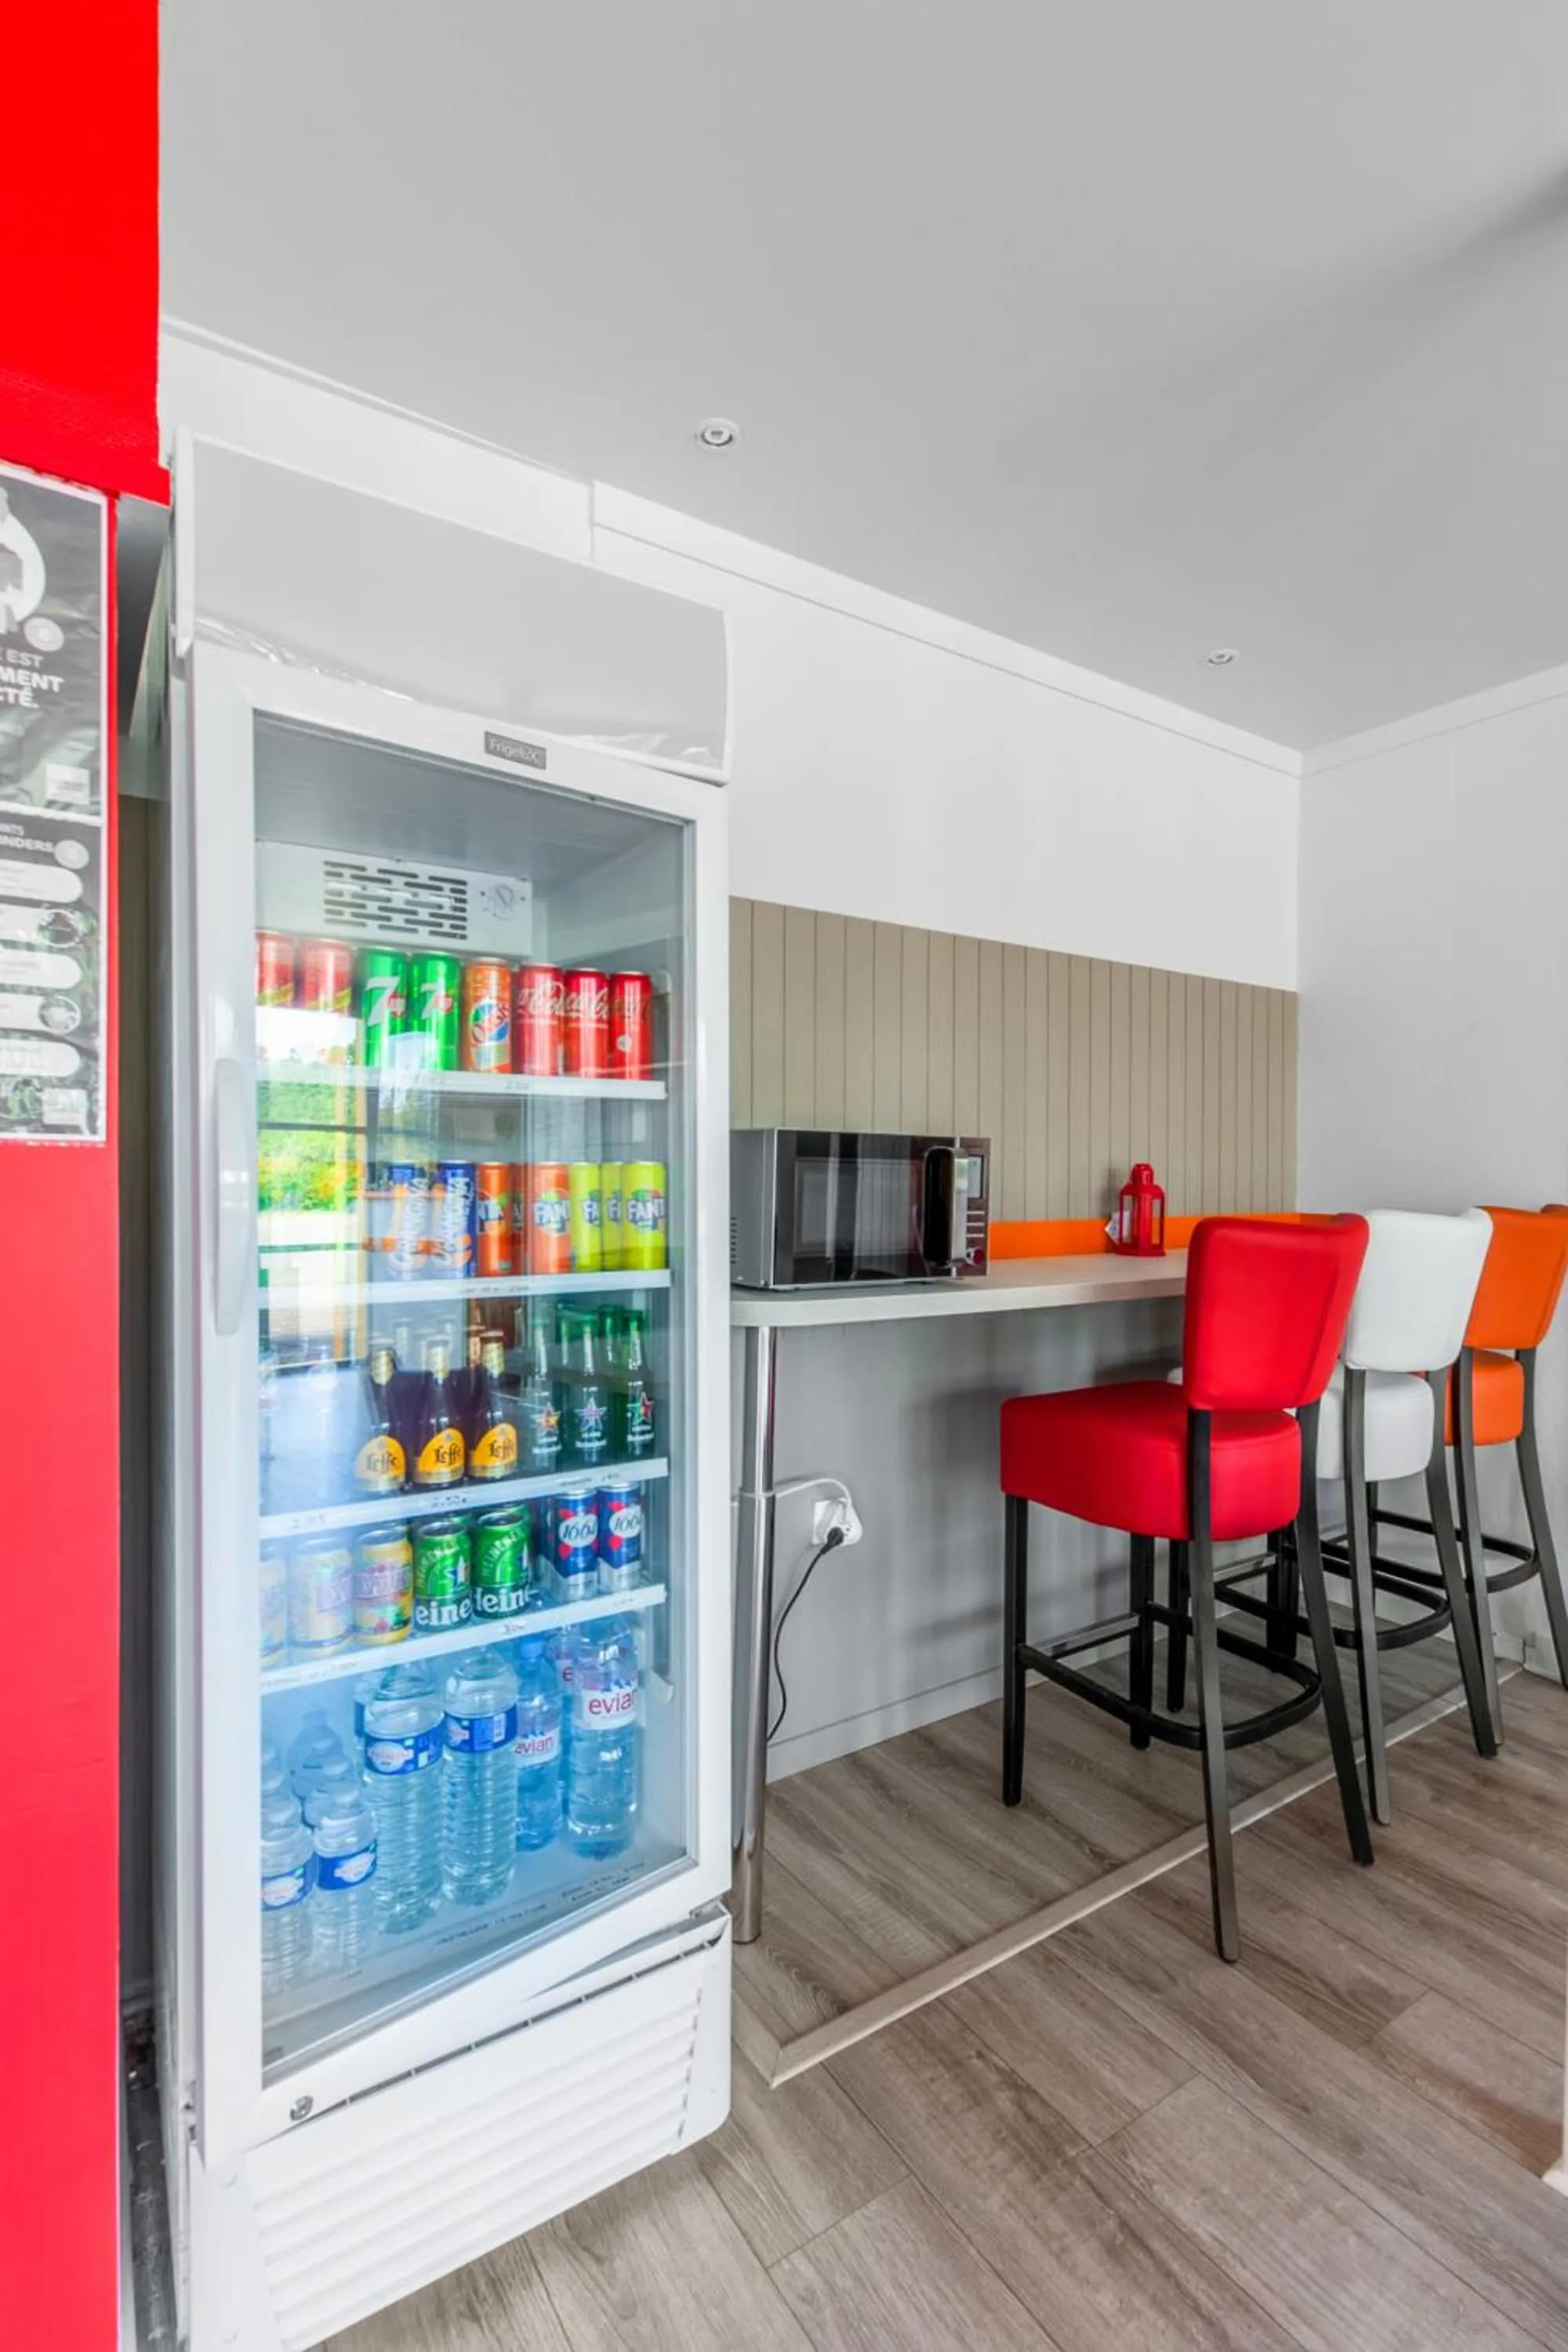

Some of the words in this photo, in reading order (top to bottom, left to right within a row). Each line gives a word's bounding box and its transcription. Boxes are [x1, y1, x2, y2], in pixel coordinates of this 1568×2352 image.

[6, 648, 45, 669] EST
[626, 1198, 665, 1223] FANT
[434, 1443, 463, 1466] Leffe
[488, 1436, 514, 1461] Leffe
[416, 1598, 471, 1626] eine
